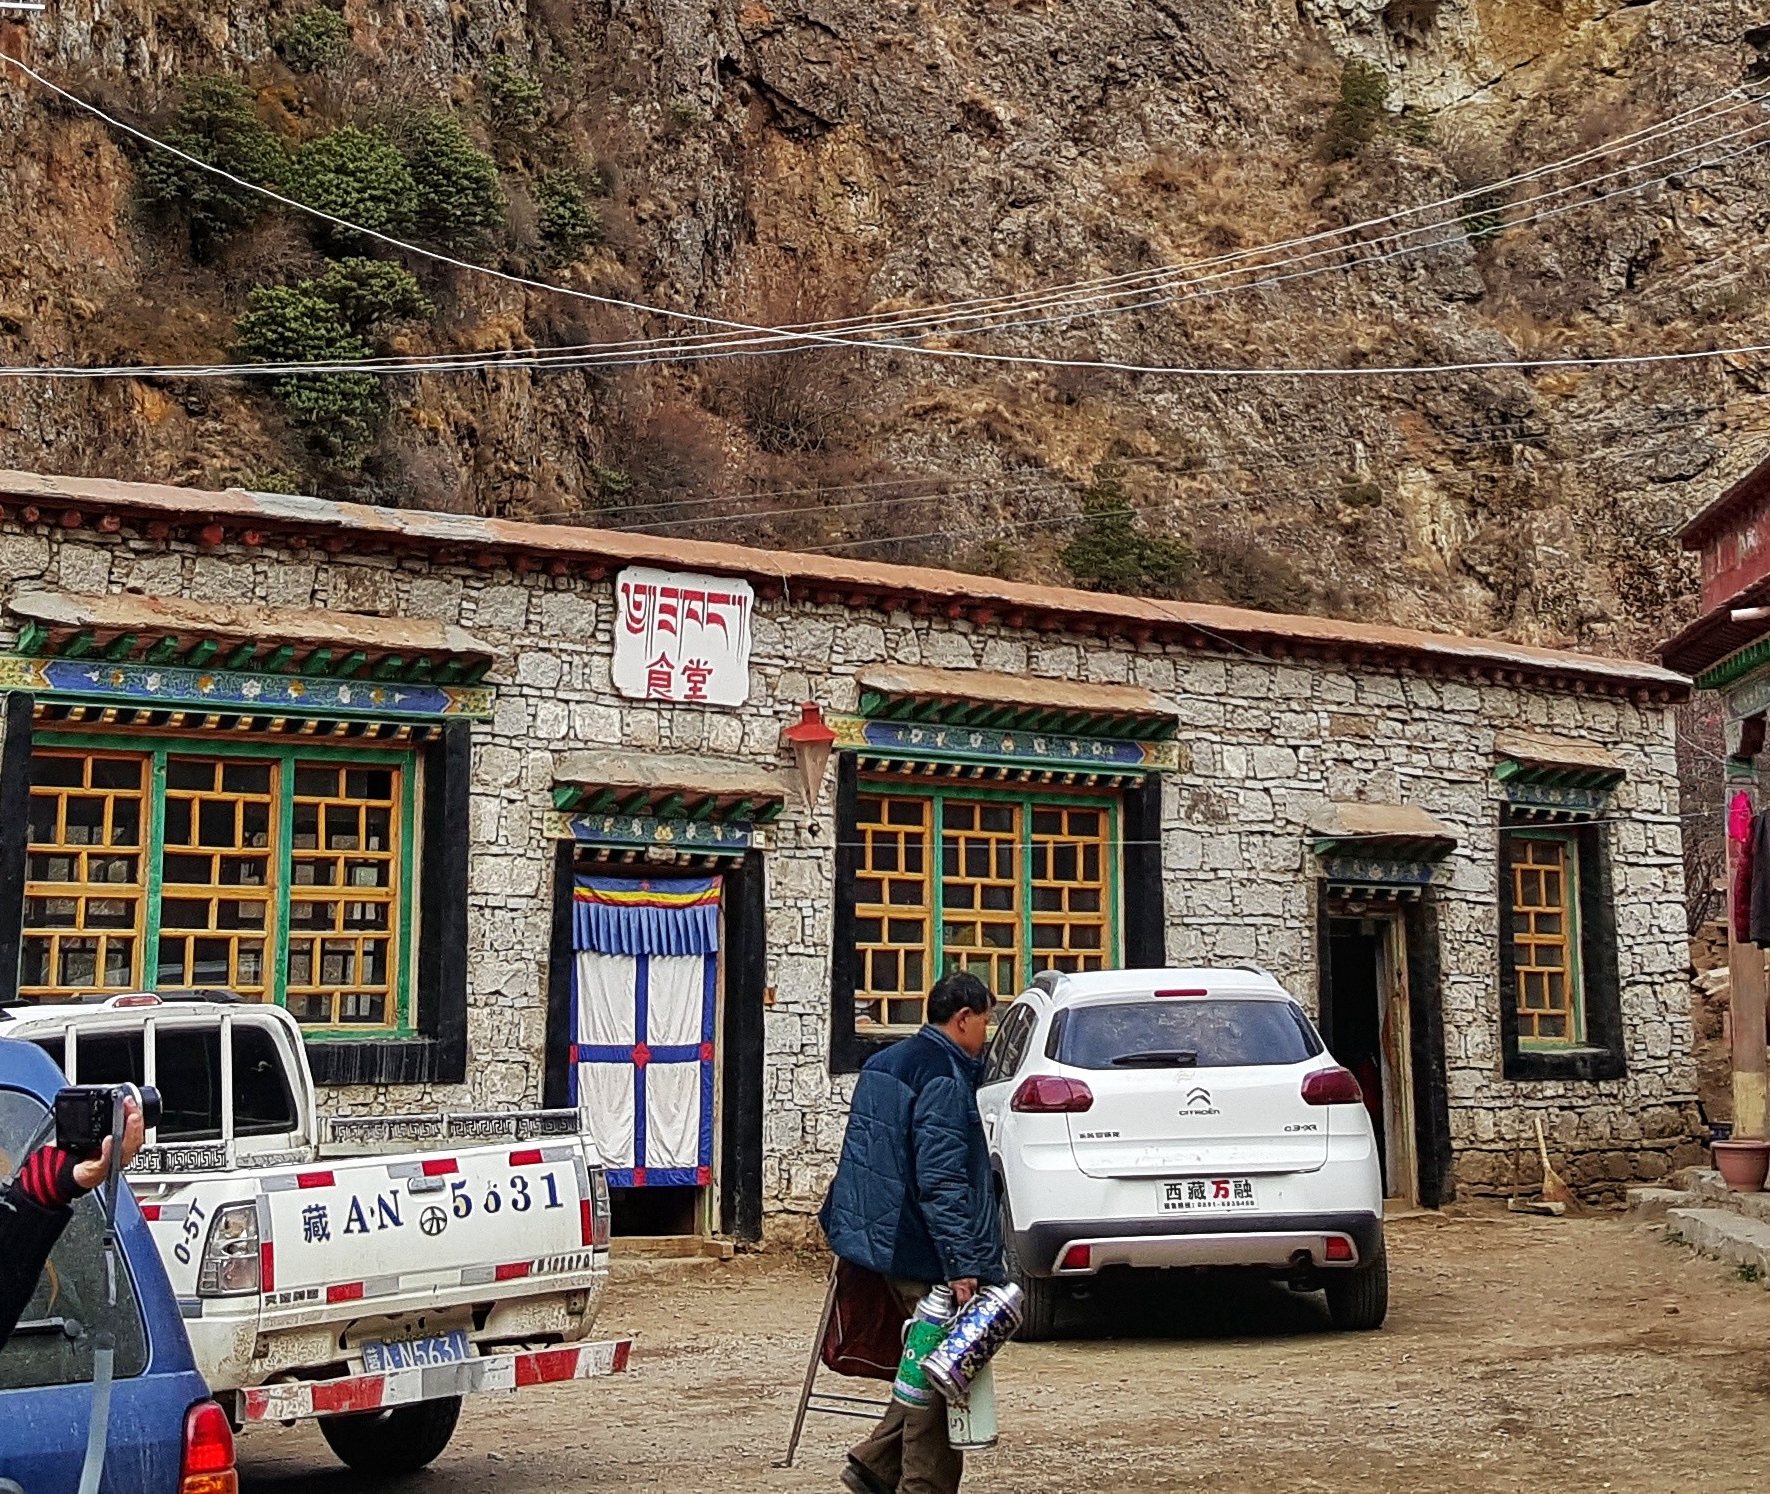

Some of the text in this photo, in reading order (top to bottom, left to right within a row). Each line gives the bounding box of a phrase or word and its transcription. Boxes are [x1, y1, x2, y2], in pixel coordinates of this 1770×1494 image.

[645, 650, 714, 701] 食堂
[1163, 1178, 1254, 1201] 西藏万融
